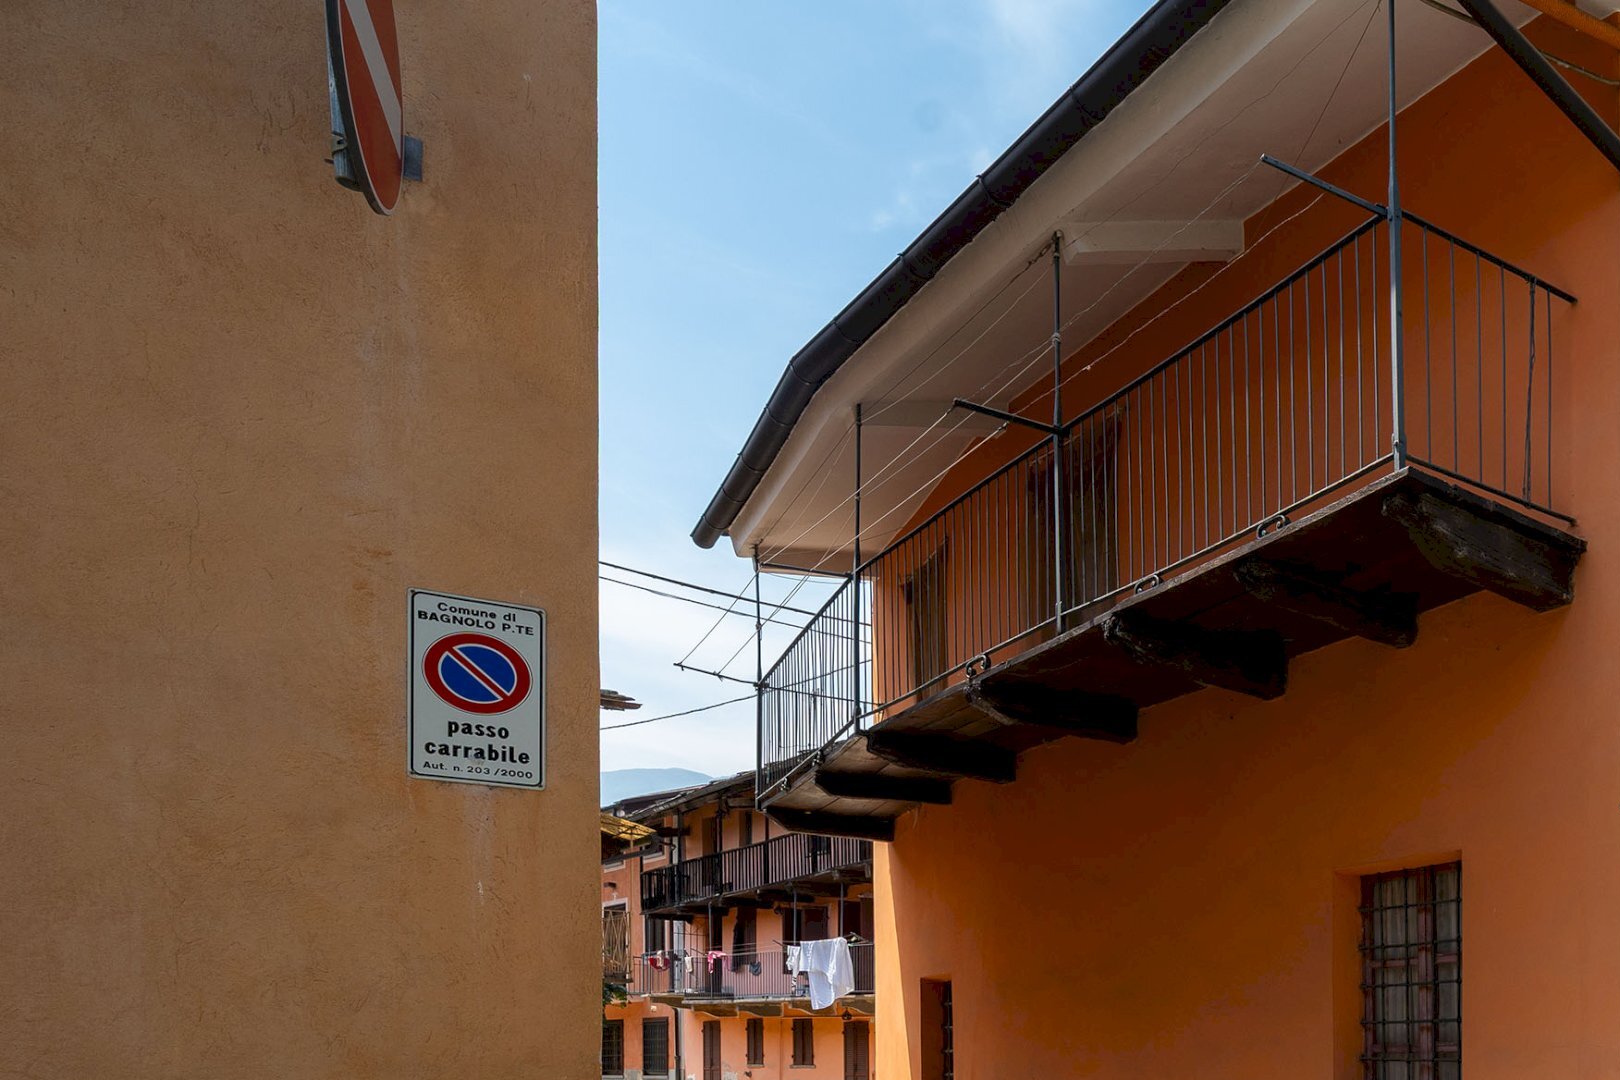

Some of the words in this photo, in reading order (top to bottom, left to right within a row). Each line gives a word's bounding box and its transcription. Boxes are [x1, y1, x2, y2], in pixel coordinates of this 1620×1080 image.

[437, 602, 497, 619] Comune
[503, 612, 516, 622] di
[417, 610, 495, 630] BAGNOLO
[502, 623, 534, 636] P.TE
[447, 720, 509, 739] passo
[424, 741, 530, 764] carrabile
[423, 761, 447, 771] Aut.
